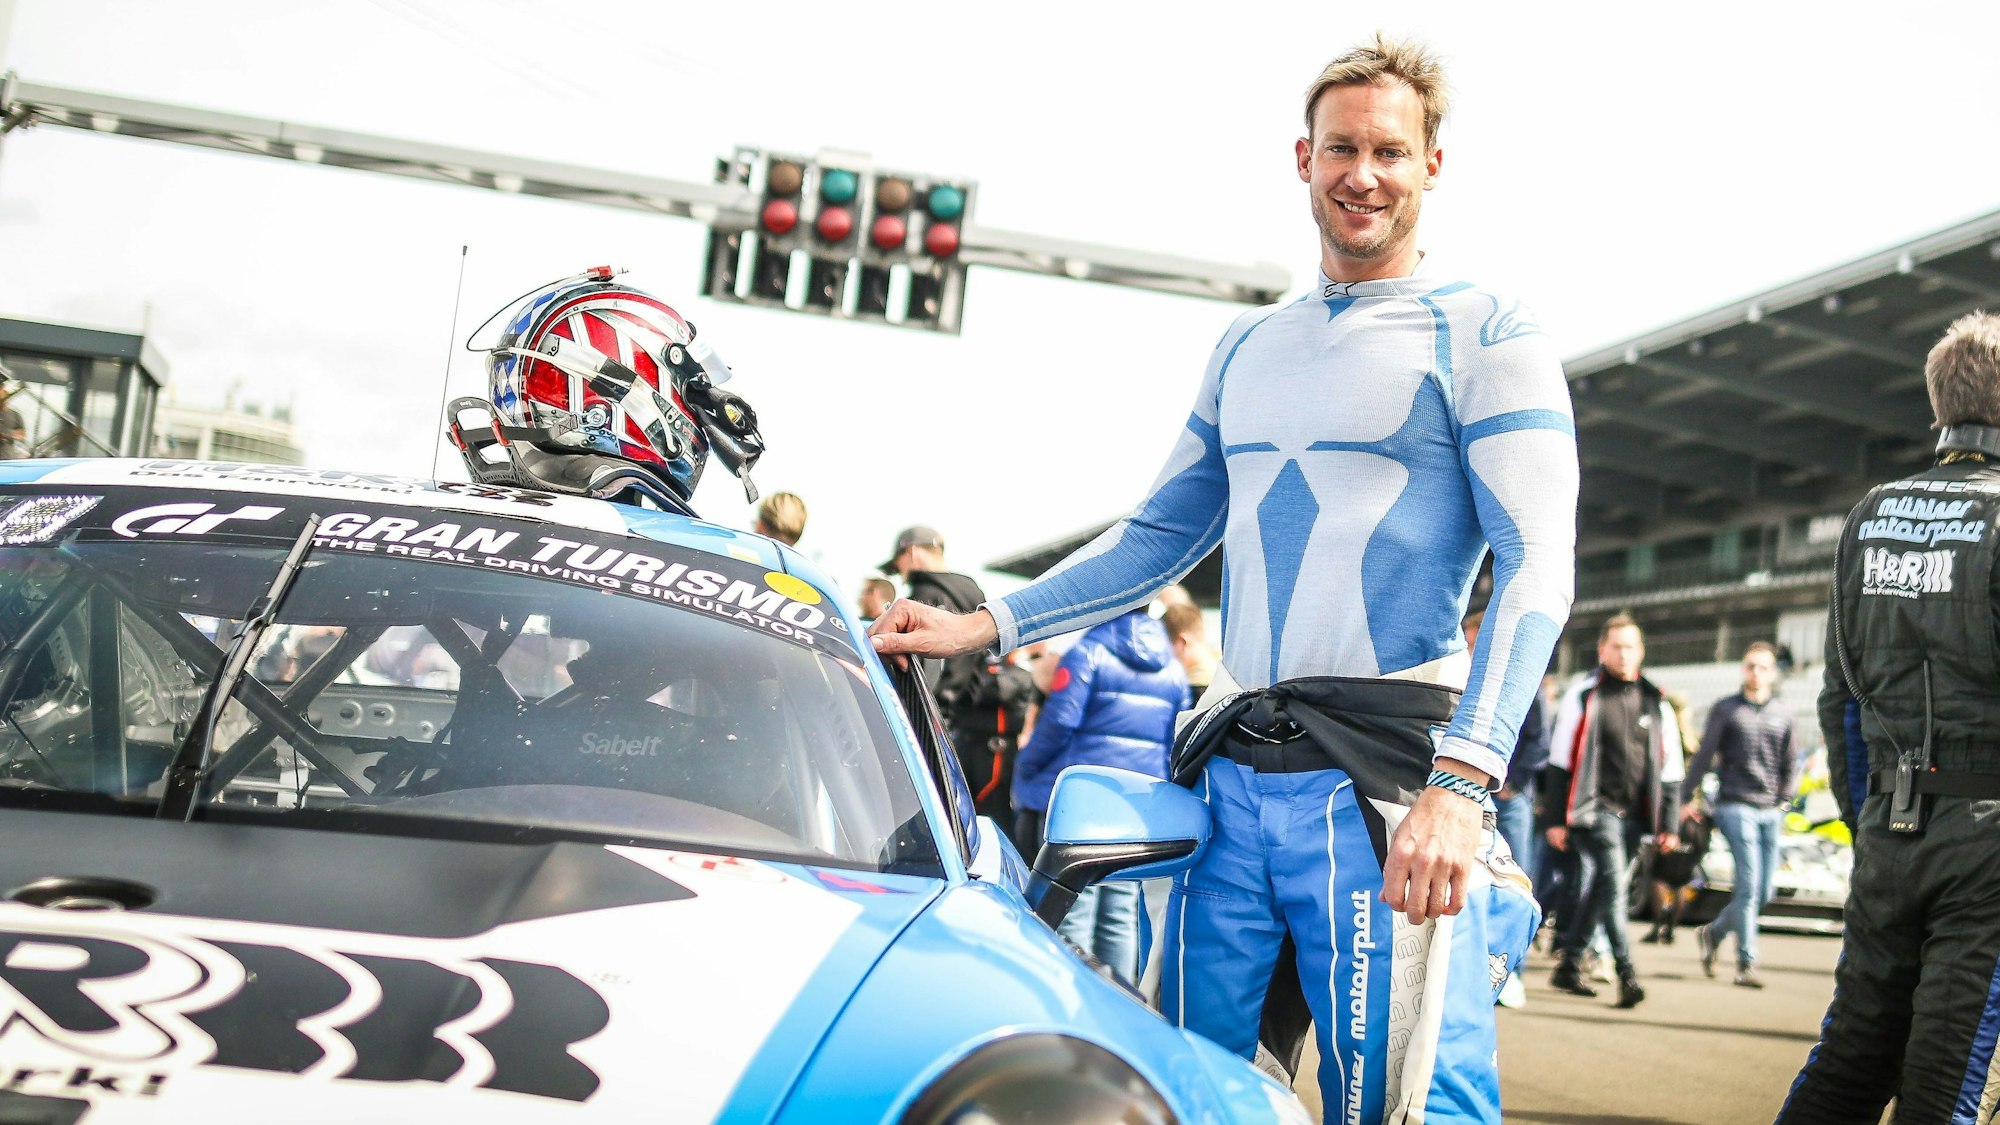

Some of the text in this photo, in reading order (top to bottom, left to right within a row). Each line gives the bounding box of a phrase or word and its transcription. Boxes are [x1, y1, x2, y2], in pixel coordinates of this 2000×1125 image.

[311, 537, 815, 645] THE REAL DRIVING SIMULATOR
[313, 512, 825, 629] GRAN TURISMO
[1863, 547, 1925, 592] H&R
[578, 731, 662, 757] Sabelt
[1349, 889, 1376, 1041] motorsport
